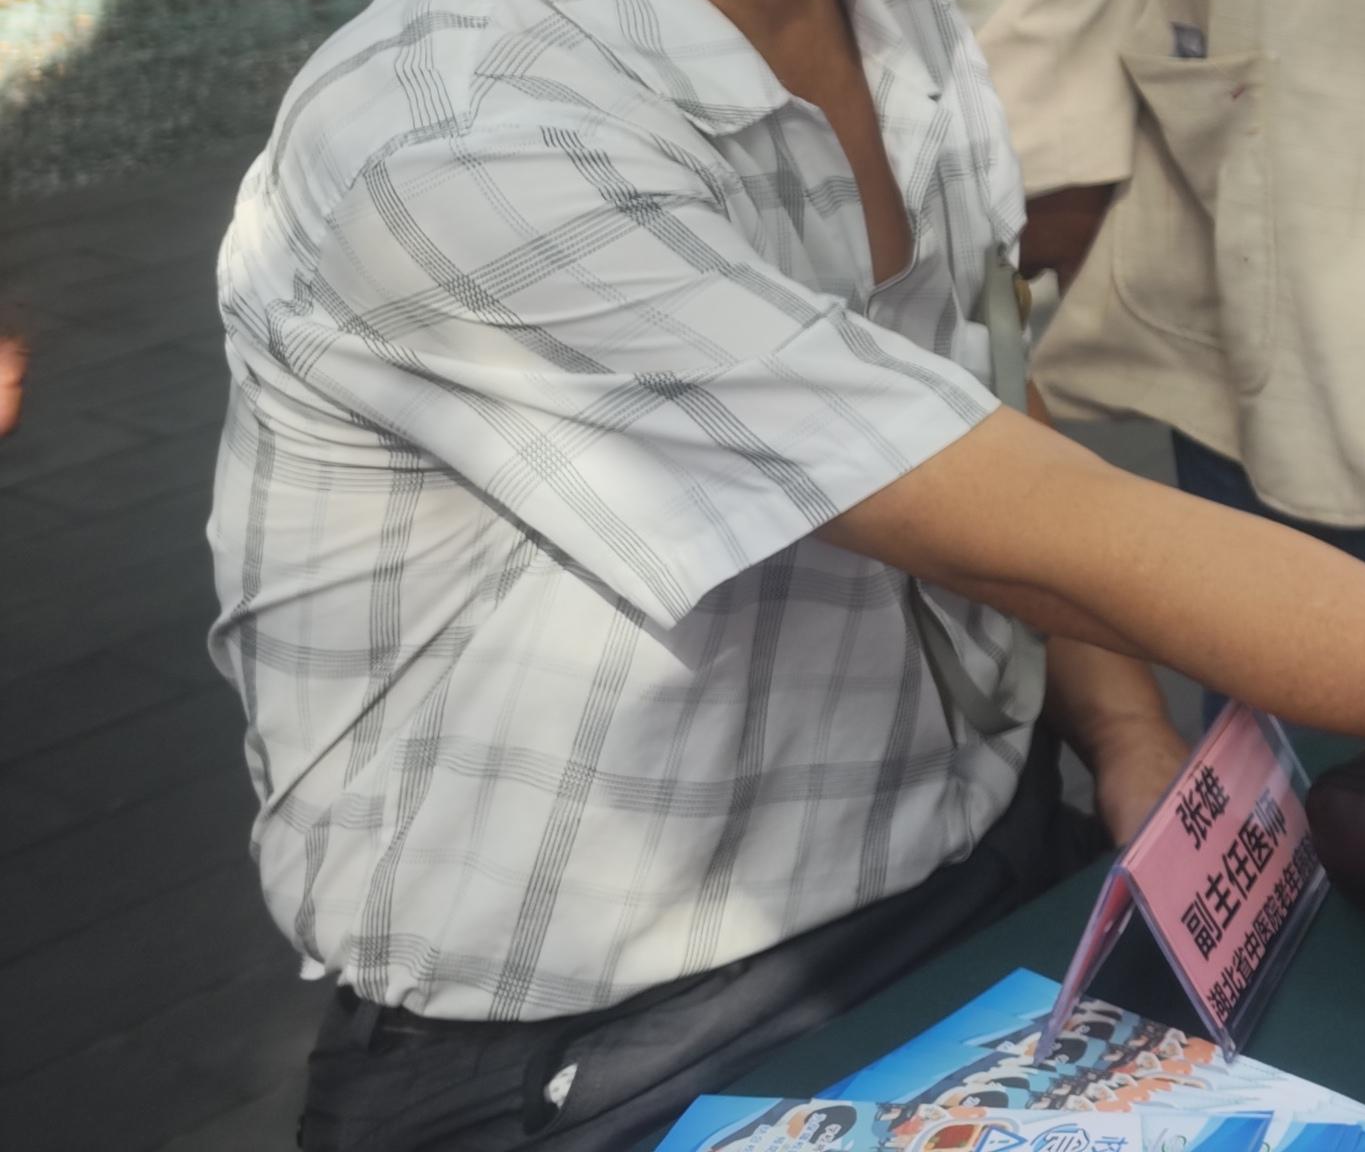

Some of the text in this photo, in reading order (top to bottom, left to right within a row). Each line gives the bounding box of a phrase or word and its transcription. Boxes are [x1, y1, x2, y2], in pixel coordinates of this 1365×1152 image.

[1176, 765, 1230, 849] 张雄
[1181, 786, 1287, 961] 副主任医师
